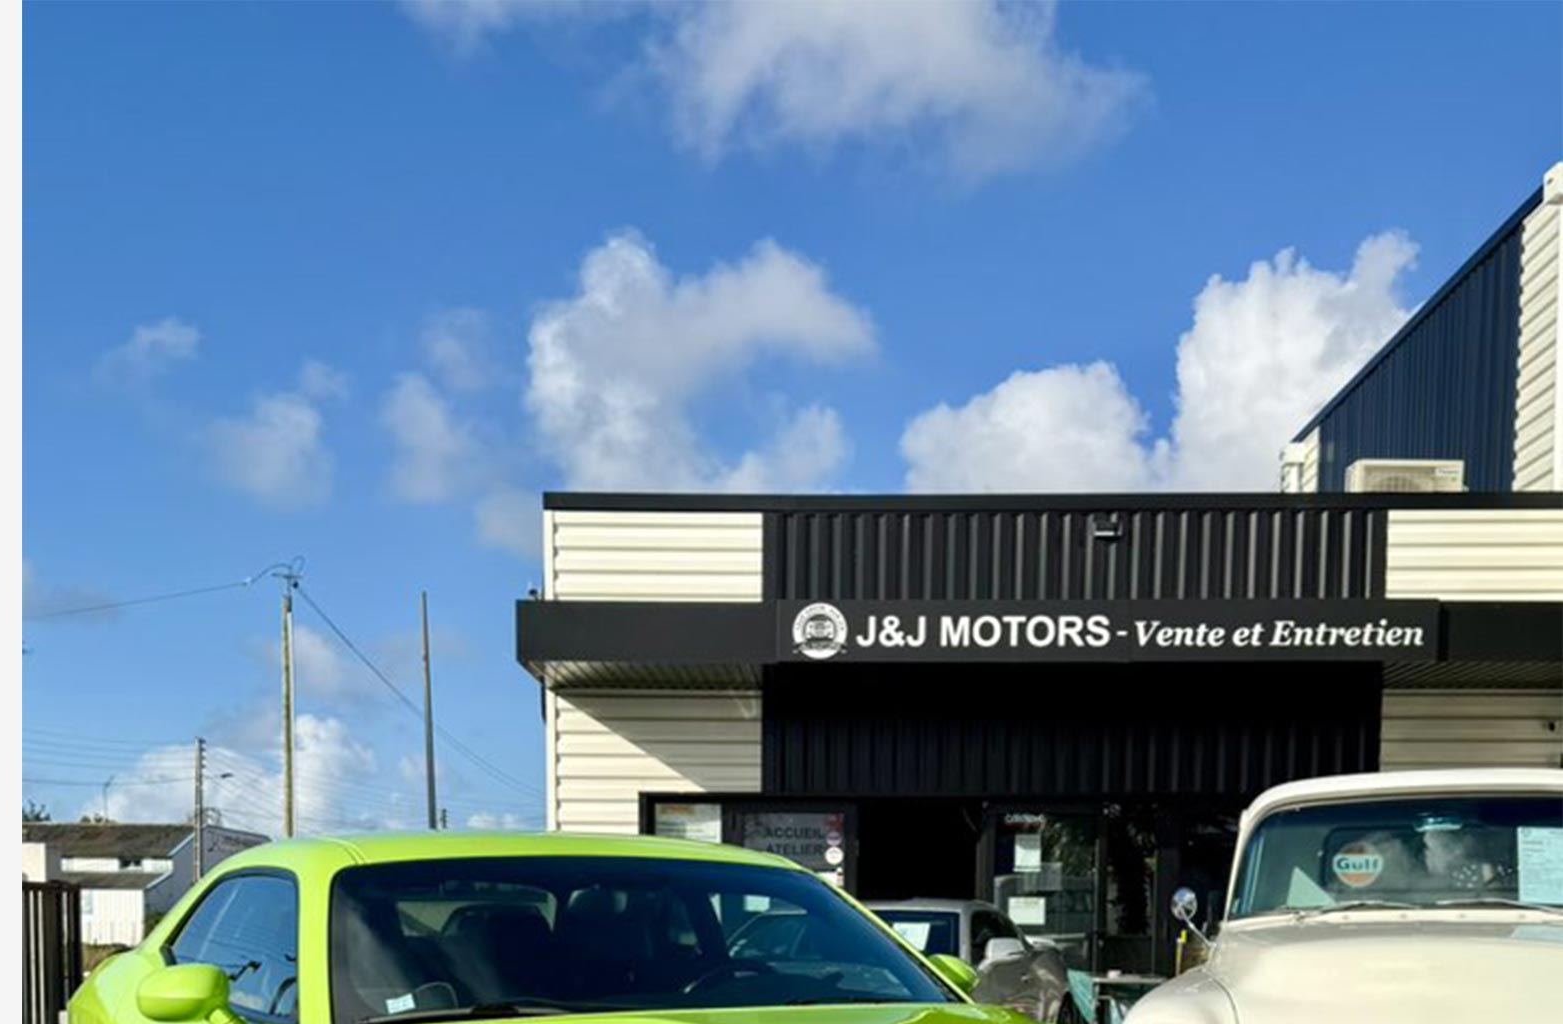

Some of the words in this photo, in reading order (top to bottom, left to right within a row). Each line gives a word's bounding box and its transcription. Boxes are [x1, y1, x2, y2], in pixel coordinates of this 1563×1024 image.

[856, 614, 927, 647] J&J
[940, 614, 1111, 648] MOTORS
[1135, 620, 1226, 647] Vente
[1233, 621, 1265, 647] et
[1269, 618, 1425, 647] Entretien
[765, 827, 825, 840] ACCUEIL
[1336, 857, 1380, 871] Gulf
